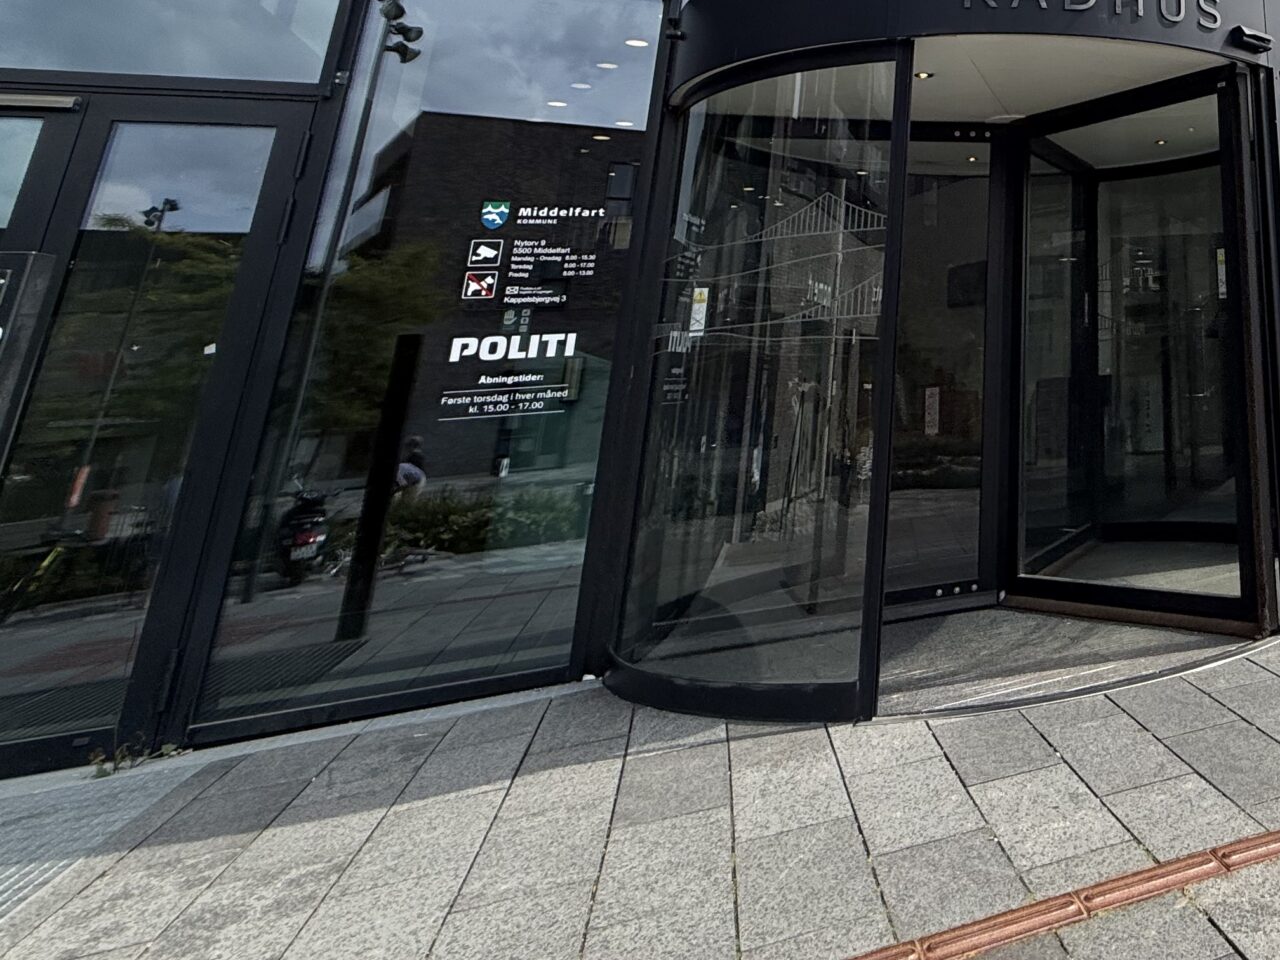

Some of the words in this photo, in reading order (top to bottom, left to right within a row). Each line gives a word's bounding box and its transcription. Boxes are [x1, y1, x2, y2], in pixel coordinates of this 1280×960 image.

[518, 206, 605, 217] Middelfart
[514, 239, 539, 247] Nytorv
[561, 294, 567, 302] 3
[449, 333, 577, 362] POLITI
[478, 374, 544, 384] Åbningstider:
[441, 396, 471, 405] Første
[473, 393, 509, 403] torsdag
[515, 391, 535, 400] hver
[537, 389, 568, 398] måned
[468, 405, 479, 413] kl.
[482, 403, 509, 413] 15.00
[519, 401, 544, 410] 17.00
